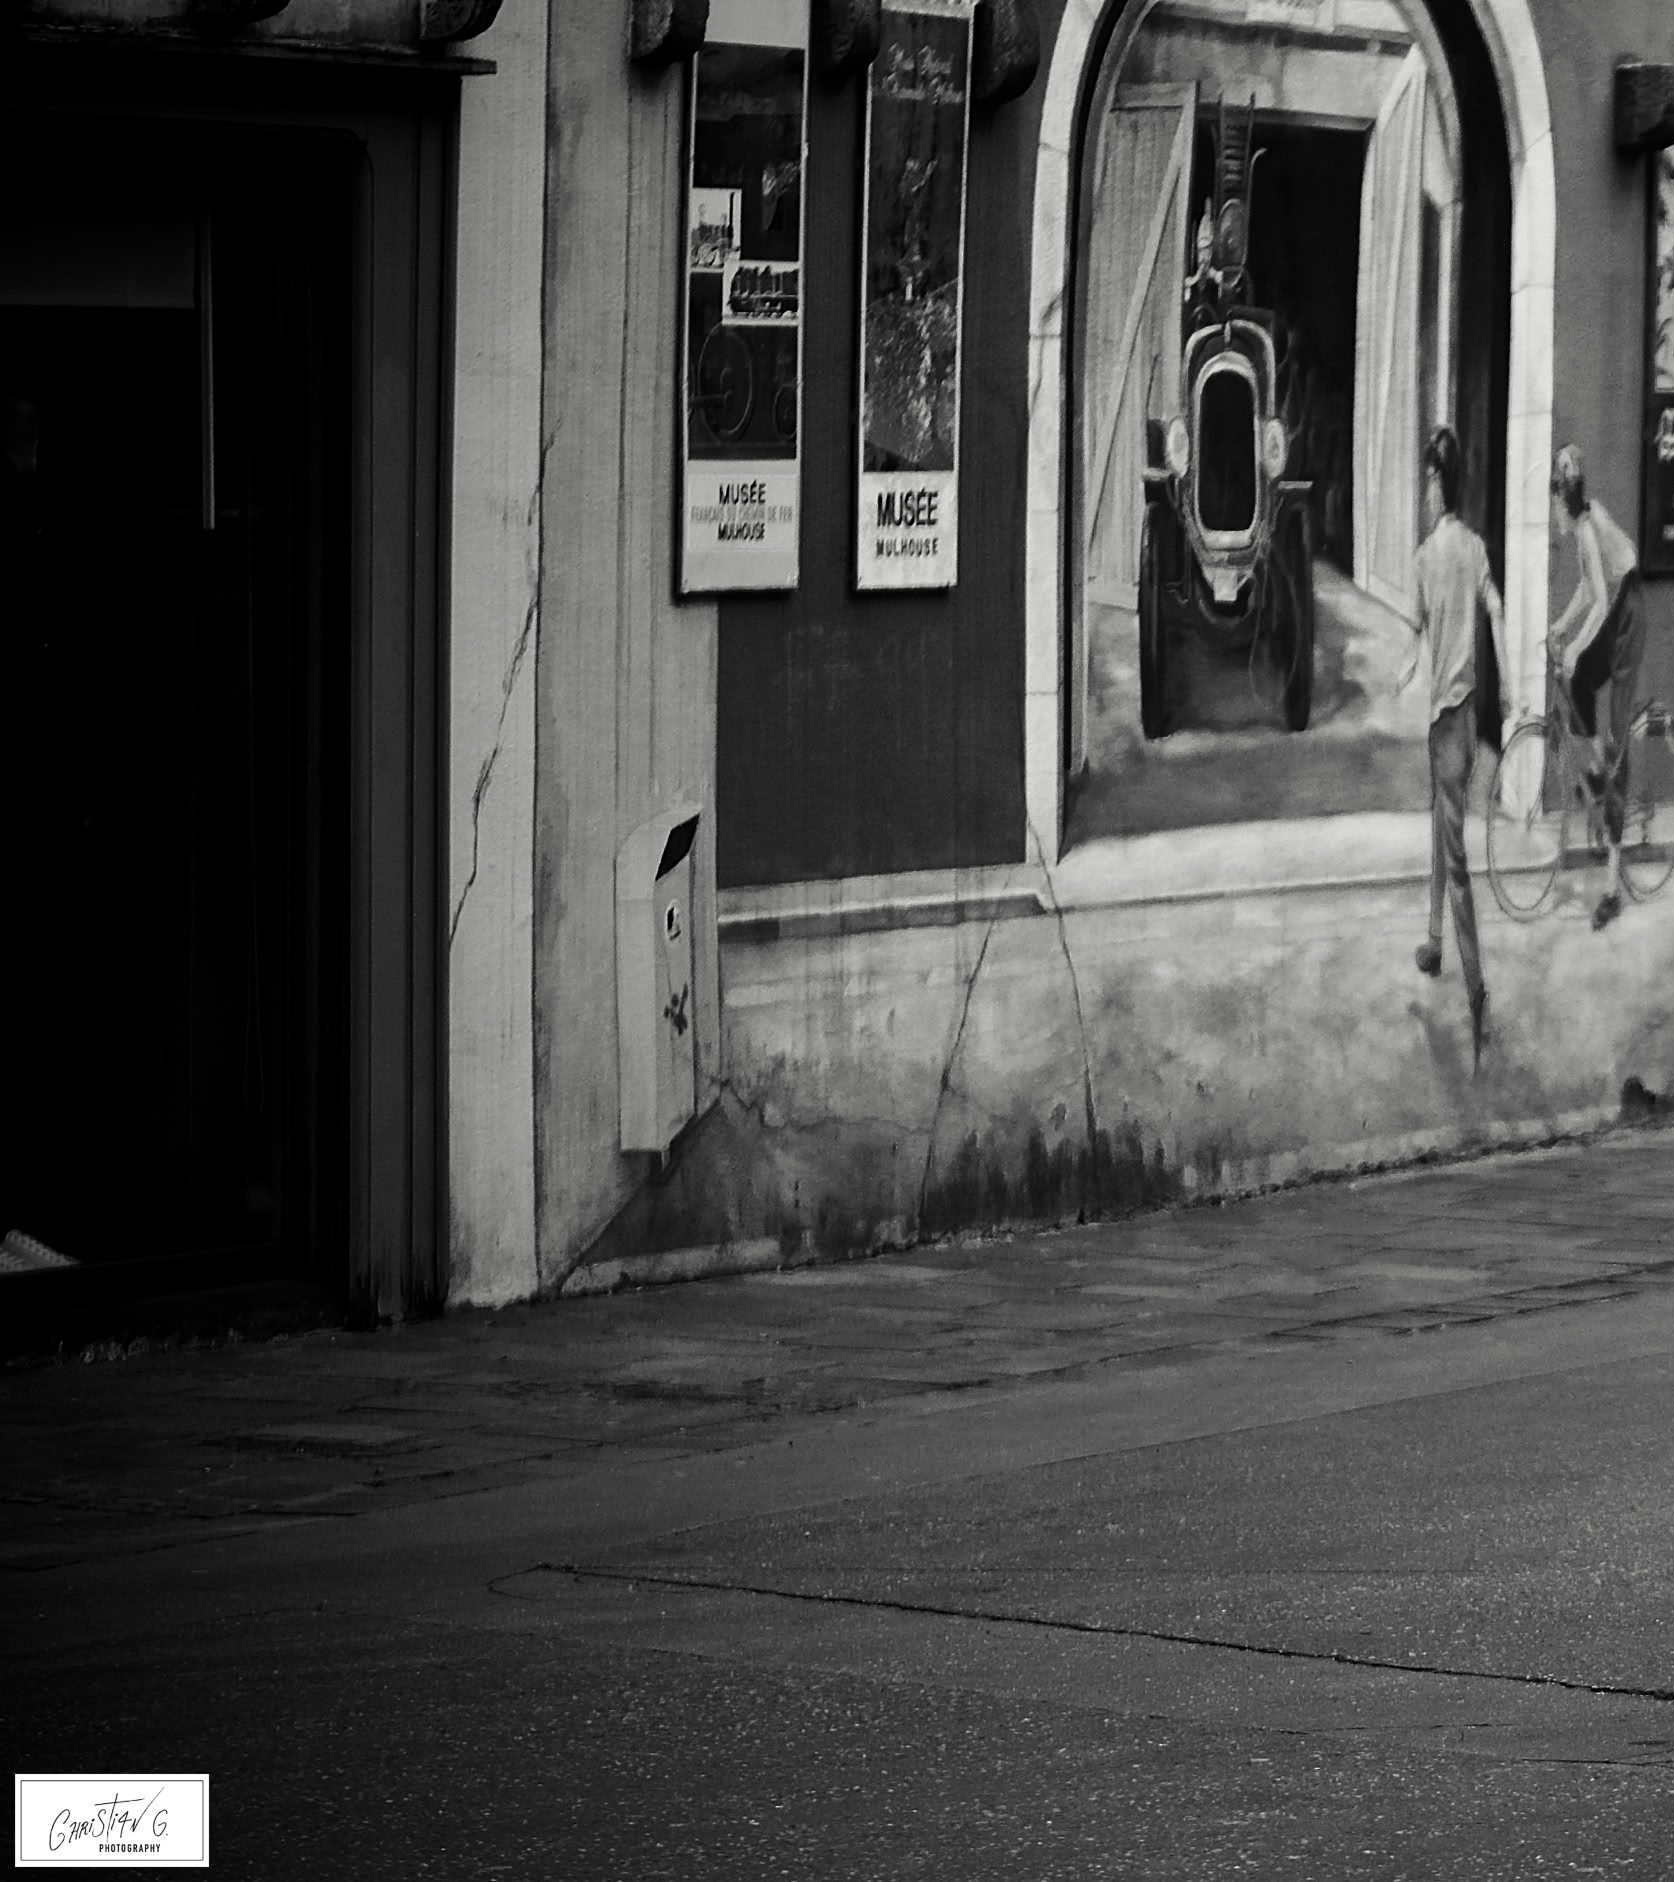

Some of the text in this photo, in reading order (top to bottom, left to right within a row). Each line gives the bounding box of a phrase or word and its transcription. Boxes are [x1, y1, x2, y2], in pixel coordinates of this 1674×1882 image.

[719, 480, 767, 505] MUSÉE
[877, 487, 939, 527] MUSÉE
[876, 538, 938, 557] MULHOUSE
